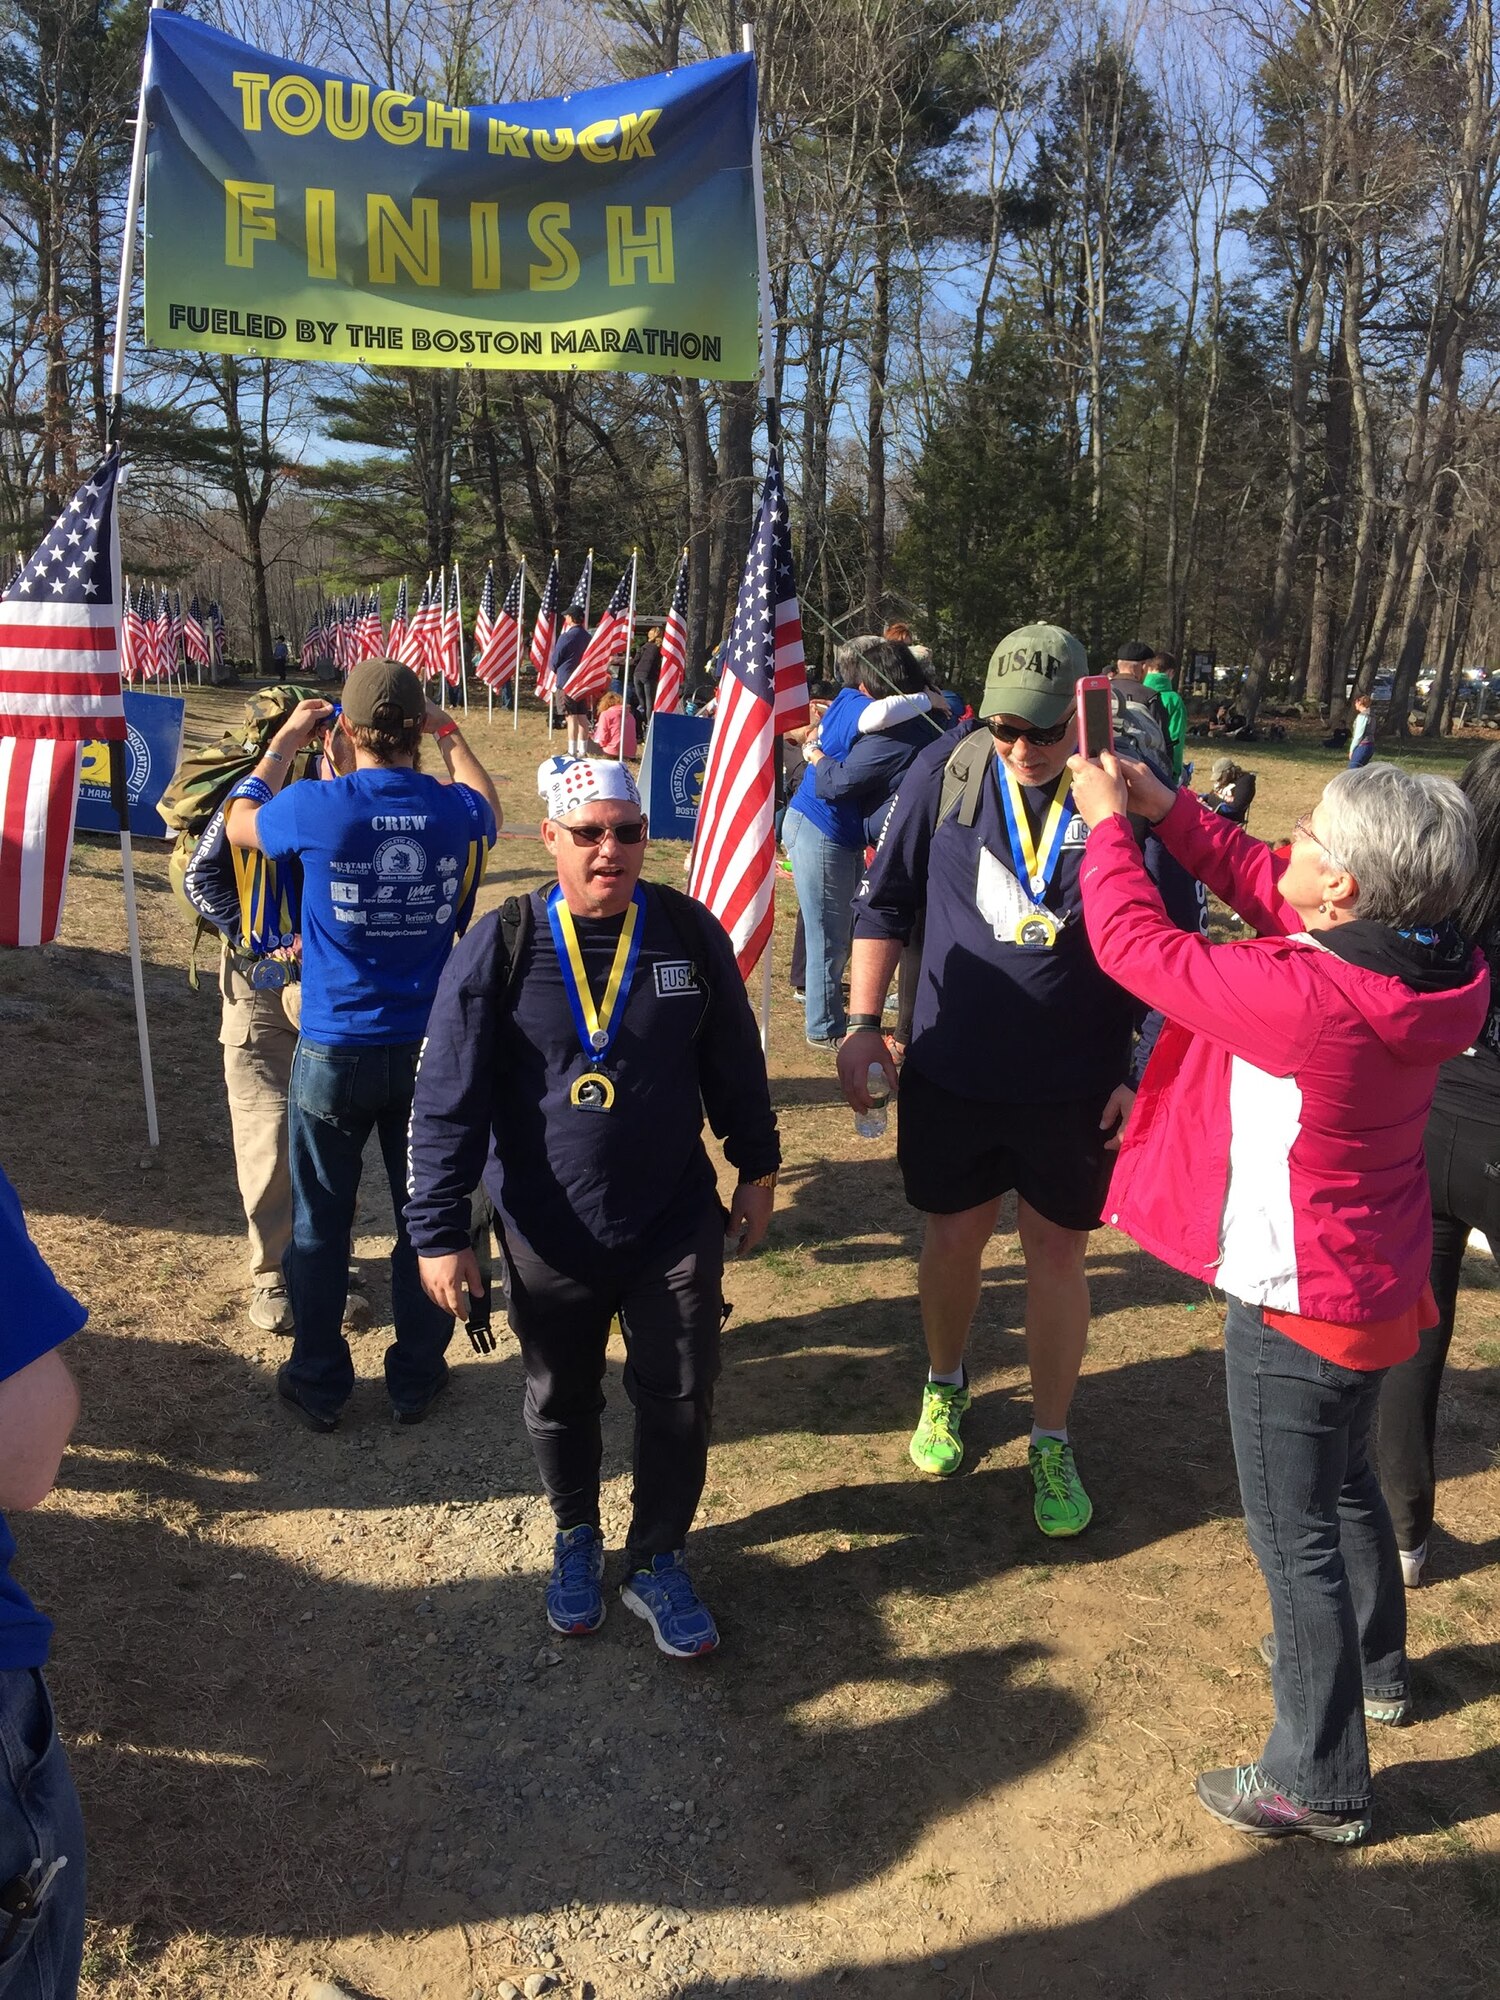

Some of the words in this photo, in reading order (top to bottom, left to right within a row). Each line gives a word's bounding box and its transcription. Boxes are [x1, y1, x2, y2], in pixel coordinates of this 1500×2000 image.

[233, 71, 470, 150] TOUGH
[488, 109, 663, 163] RUCK
[224, 179, 676, 292] FINISH
[169, 303, 287, 340] FUELED
[295, 318, 338, 345] BY
[346, 323, 403, 350] THE
[412, 328, 542, 354] BOSTON
[551, 327, 722, 362] MARATHON
[997, 648, 1061, 681] USAF
[127, 728, 148, 788] SOCIATION
[673, 763, 686, 800] BOSTON
[685, 745, 711, 766] ATHLE
[371, 815, 428, 831] CREW
[675, 806, 699, 816] BOSTO
[1071, 822, 1089, 840] US
[667, 968, 692, 987] US
